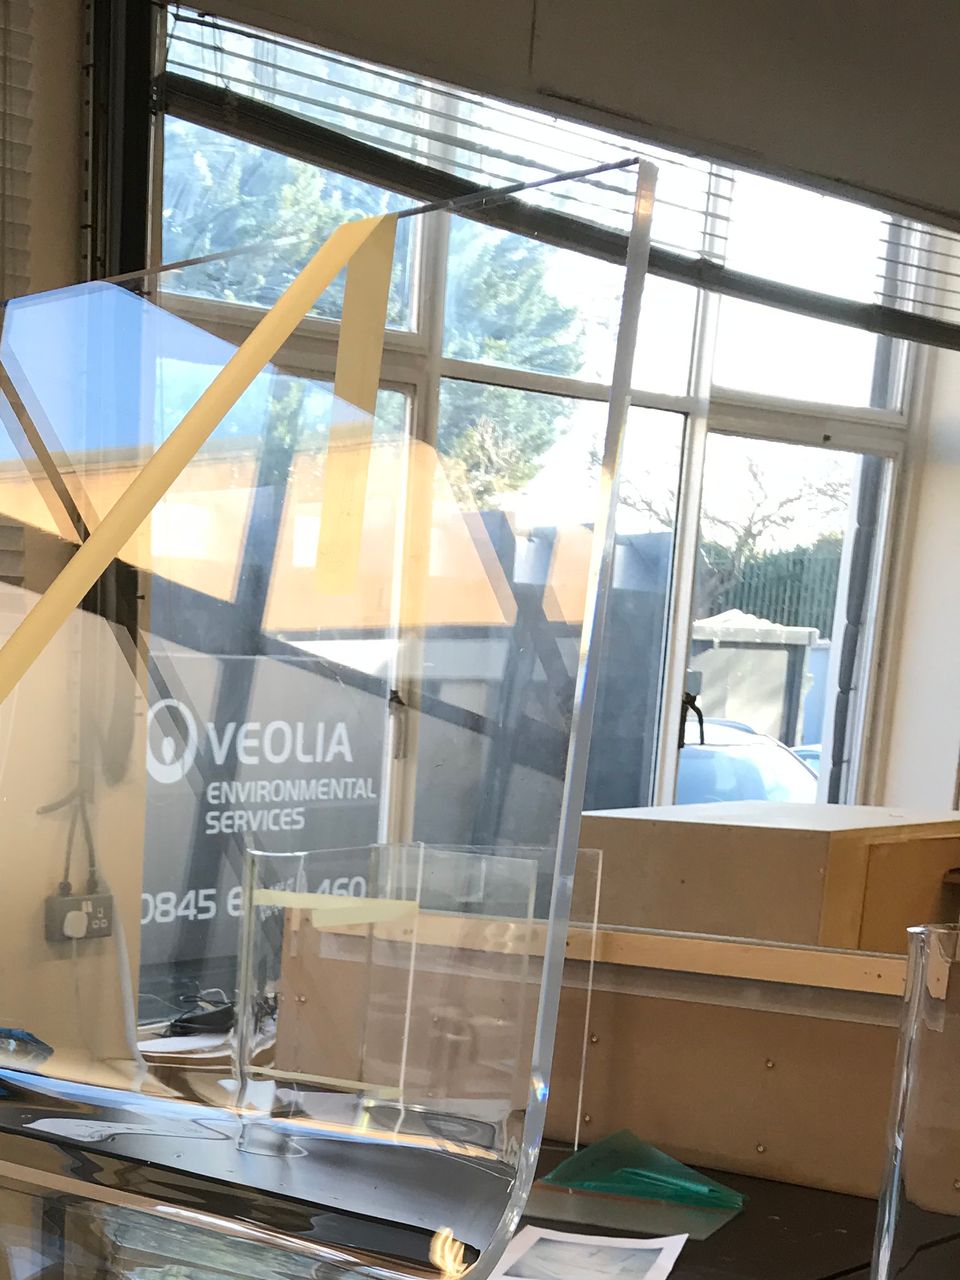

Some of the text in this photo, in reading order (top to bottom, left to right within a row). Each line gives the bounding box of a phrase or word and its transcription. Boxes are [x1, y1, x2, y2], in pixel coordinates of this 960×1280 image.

[206, 720, 353, 765] VEOLIA
[206, 777, 376, 805] ENVIRONMENTAL
[205, 807, 305, 834] SERVICES
